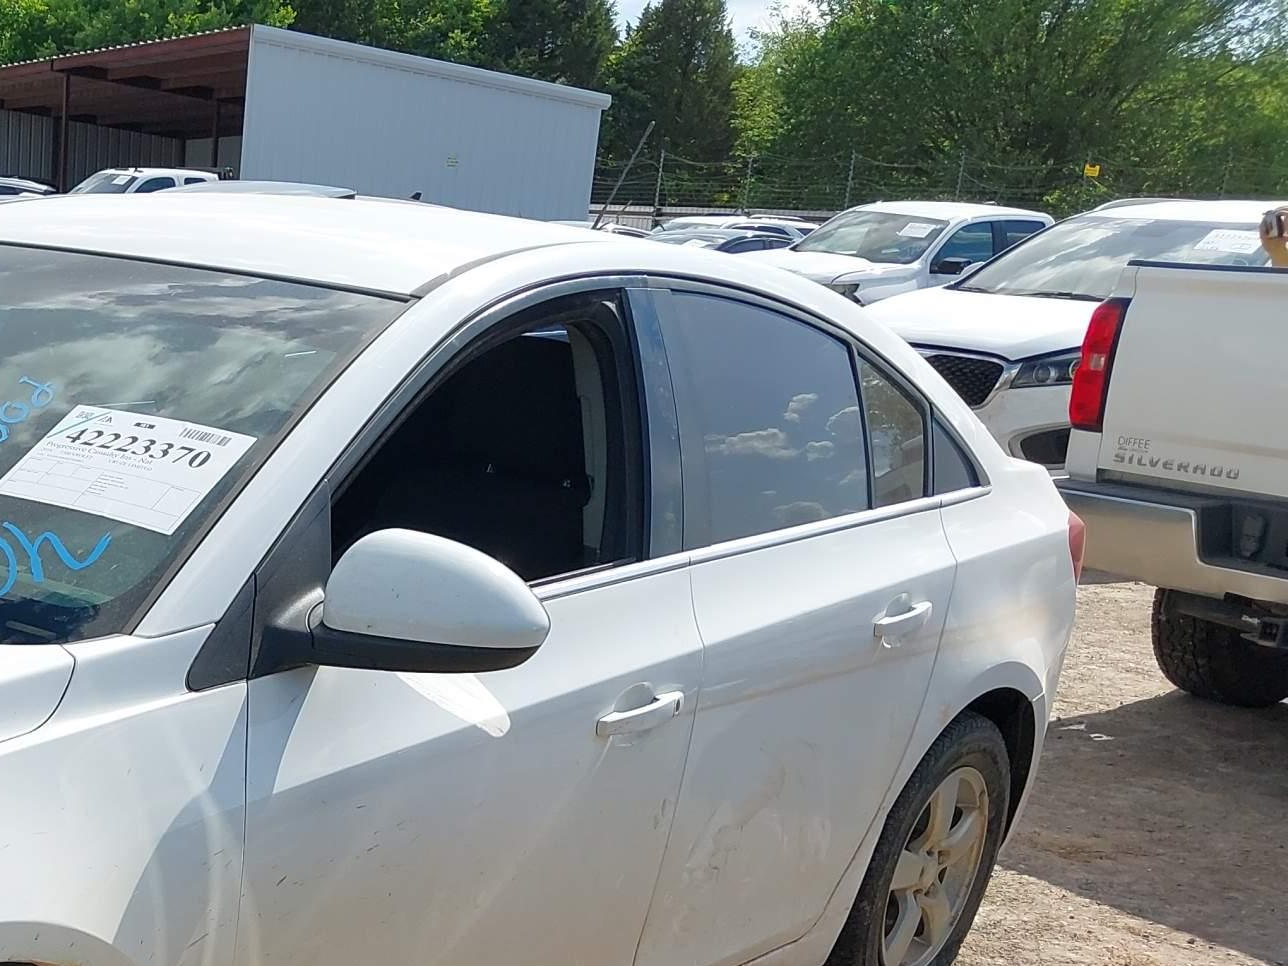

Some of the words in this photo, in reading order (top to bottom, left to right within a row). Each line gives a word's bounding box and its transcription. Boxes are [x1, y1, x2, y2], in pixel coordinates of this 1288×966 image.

[65, 427, 212, 469] 42223370
[1117, 435, 1152, 450] DIFFEE
[1112, 453, 1240, 480] SILVERADO
